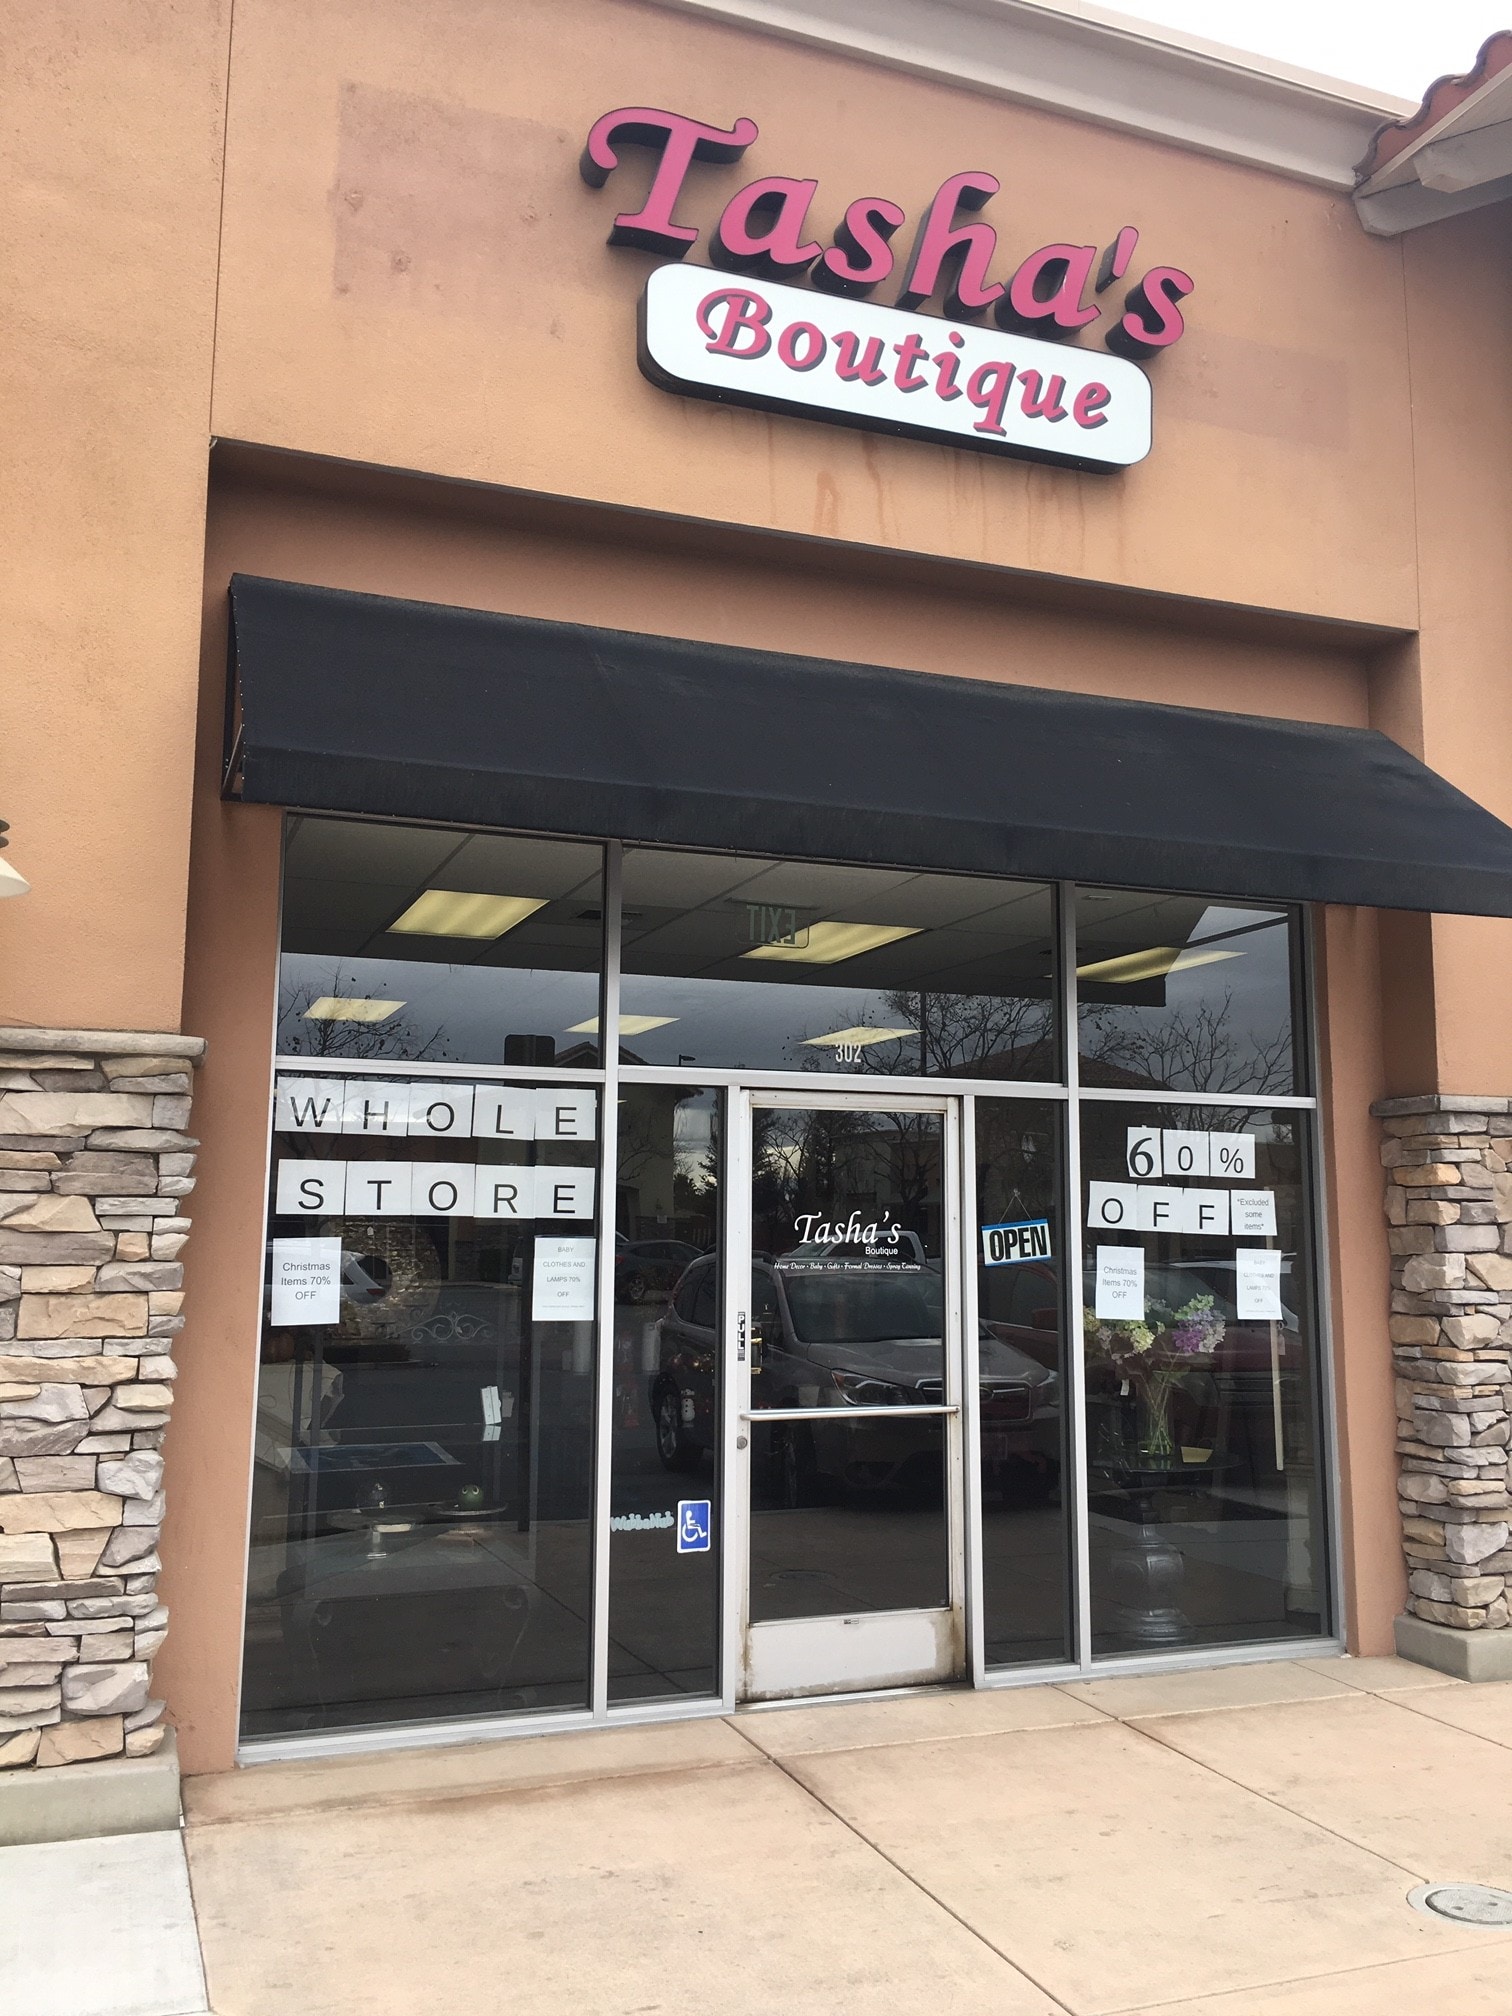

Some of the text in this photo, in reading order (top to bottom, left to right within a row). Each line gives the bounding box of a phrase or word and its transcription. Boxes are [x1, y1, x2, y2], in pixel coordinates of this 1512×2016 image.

[583, 106, 1195, 350] Tasha's
[695, 287, 1113, 437] Boutique
[835, 1042, 862, 1063] 302
[289, 1095, 578, 1136] WHOLE
[1129, 1137, 1245, 1177] 60%
[297, 1178, 577, 1215] STORE
[794, 1210, 902, 1244] Tasha's
[1101, 1198, 1216, 1230] OFF
[865, 1246, 899, 1255] Boutique
[989, 1225, 1048, 1262] OPEN
[281, 1276, 331, 1286] Items 70%
[282, 1262, 331, 1271] Christmas
[1103, 1266, 1137, 1275] Christmas
[295, 1291, 317, 1300] OFF
